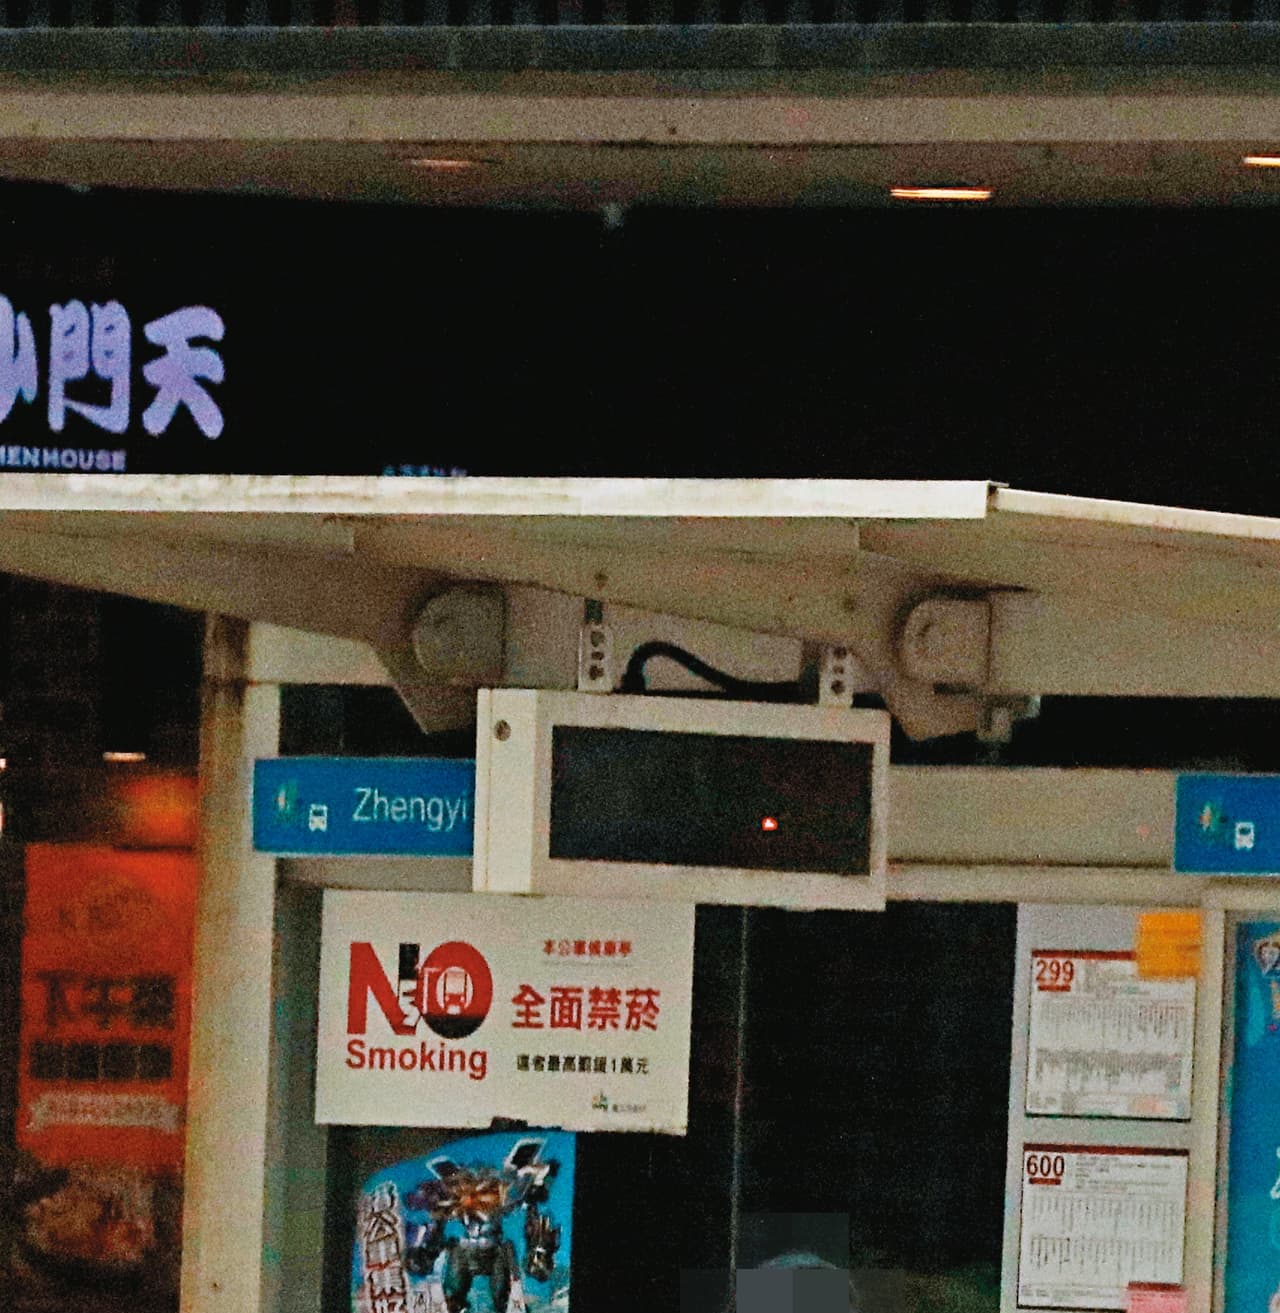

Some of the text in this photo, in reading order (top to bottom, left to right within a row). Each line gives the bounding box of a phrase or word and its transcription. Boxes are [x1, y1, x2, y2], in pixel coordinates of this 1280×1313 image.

[352, 787, 468, 833] Zhengyi
[347, 940, 494, 1040] NO
[1035, 959, 1075, 984] 299
[511, 983, 661, 1032] 全面禁菸
[345, 1039, 488, 1080] Smoking
[1025, 1154, 1065, 1178] 600
